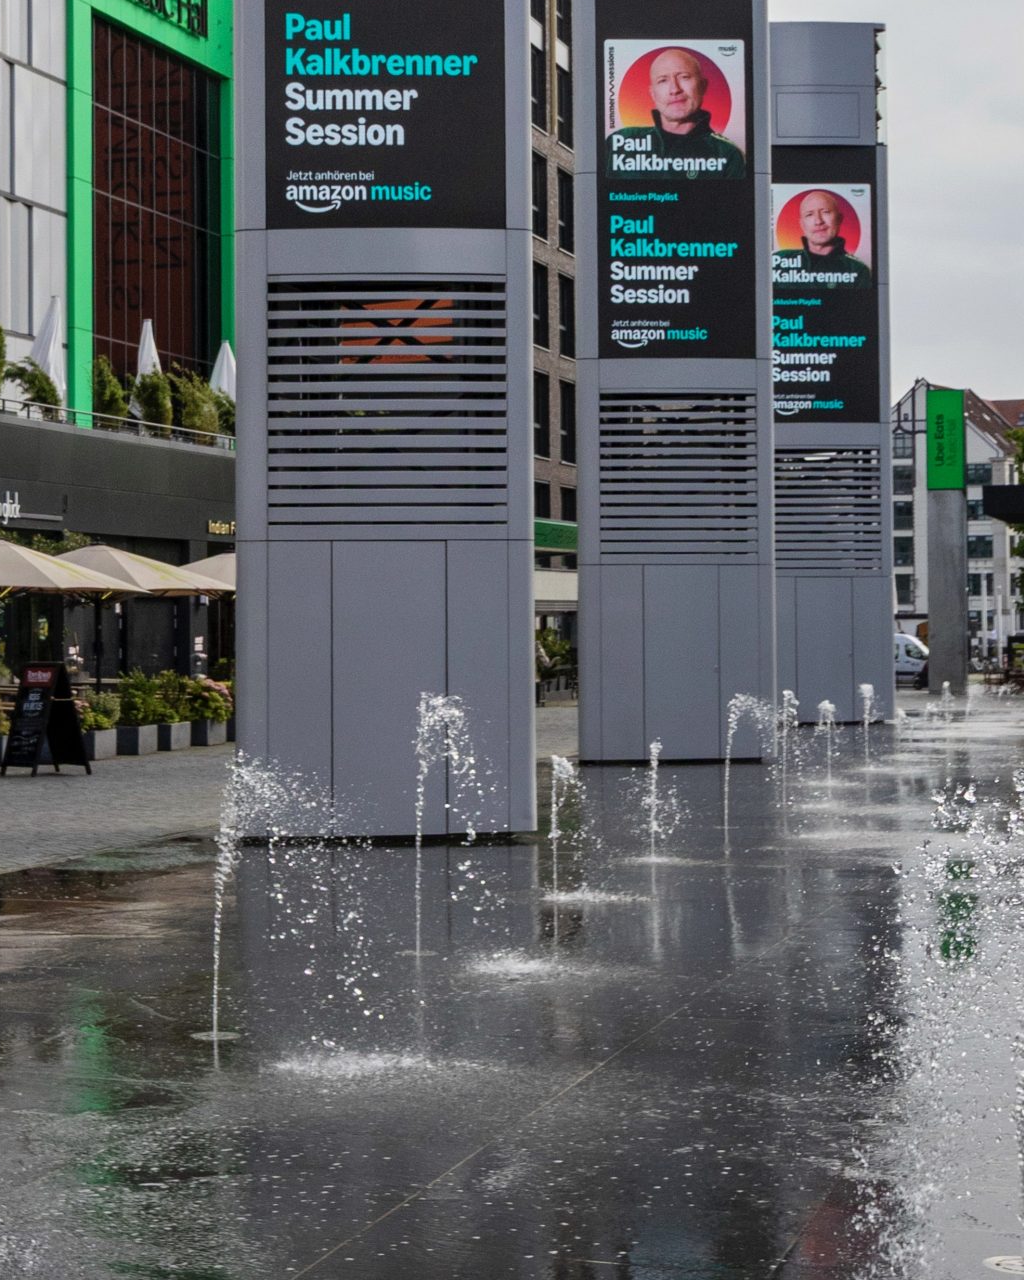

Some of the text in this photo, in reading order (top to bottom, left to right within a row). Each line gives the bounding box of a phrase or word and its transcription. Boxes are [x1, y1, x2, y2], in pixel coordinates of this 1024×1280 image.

[285, 13, 351, 41] Paul
[285, 48, 478, 76] Kalkbrenner
[284, 81, 418, 111] Summer
[284, 116, 404, 146] Session
[612, 135, 652, 151] Paul
[612, 154, 726, 171] Kalkbrenner
[286, 170, 375, 181] Jetzt anhören bei
[285, 181, 432, 201] amazon music
[610, 215, 654, 234] Paul
[610, 238, 738, 257] Kalkbrenner
[772, 255, 801, 268] Paul
[610, 261, 698, 281] Summer
[772, 269, 857, 283] Kalkbrenner
[610, 284, 690, 304] Session
[771, 315, 803, 330] Paul
[611, 327, 708, 340] amazon music
[771, 333, 866, 347] Kalkbrenner
[771, 350, 837, 364] Summer
[771, 367, 830, 382] Session
